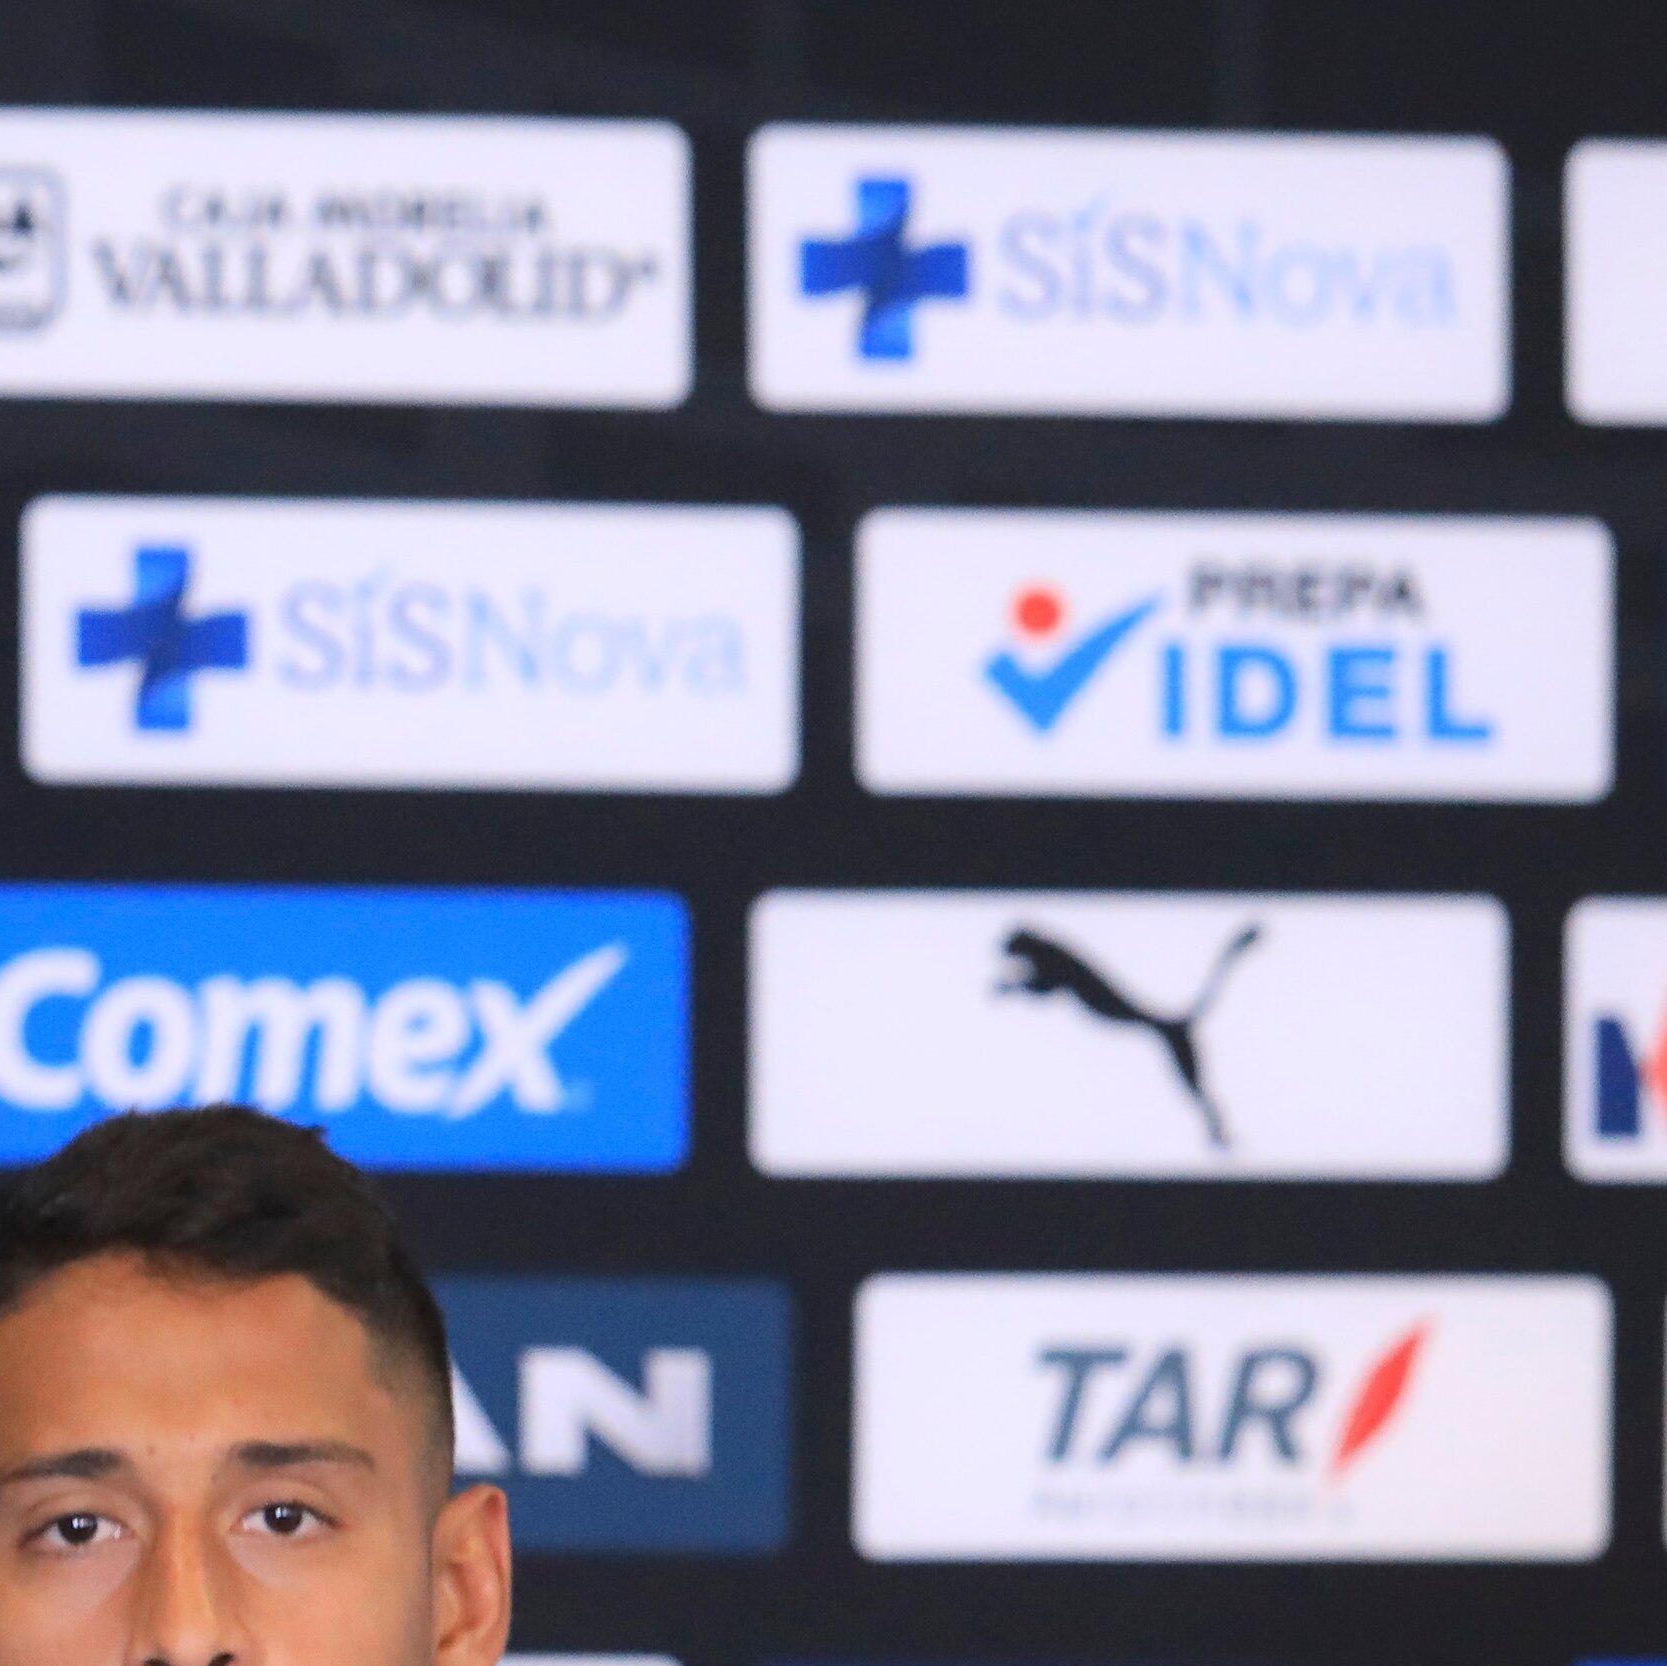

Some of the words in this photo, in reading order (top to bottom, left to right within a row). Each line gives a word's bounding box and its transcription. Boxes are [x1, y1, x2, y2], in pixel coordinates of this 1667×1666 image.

[93, 242, 635, 322] VALLADOLID
[1189, 559, 1426, 622] PREPA
[1161, 643, 1491, 742] IDEL
[1034, 1342, 1320, 1465] TAR
